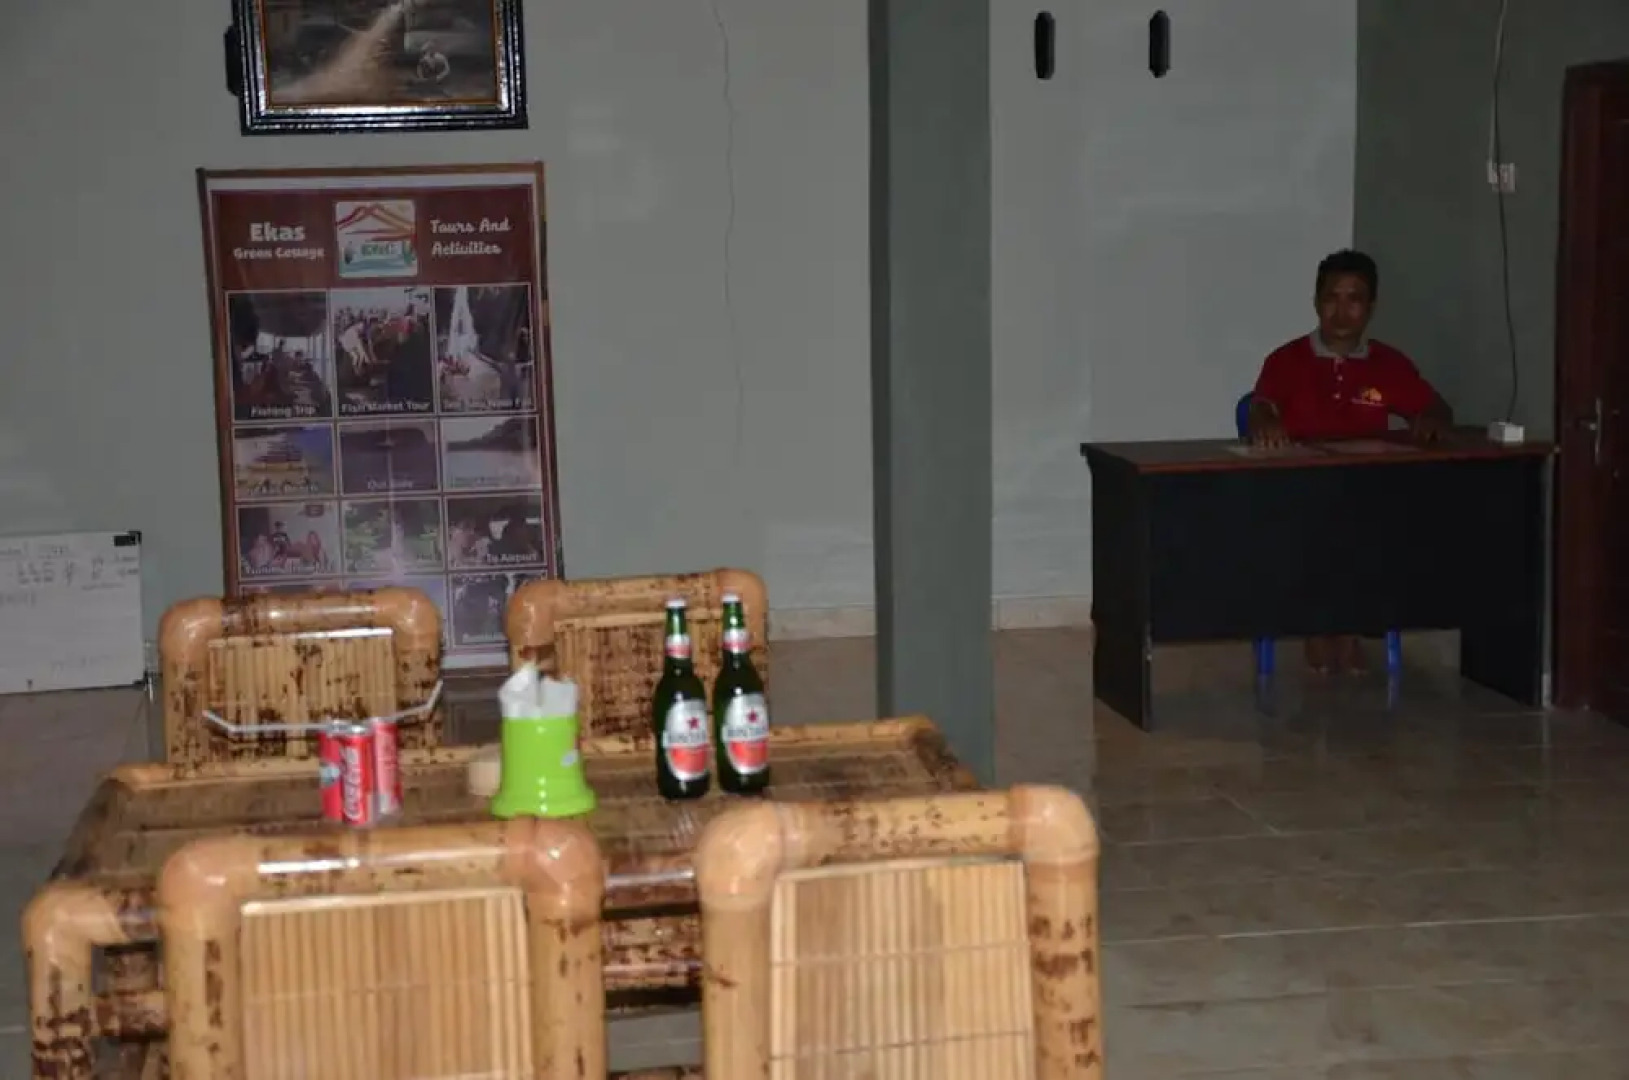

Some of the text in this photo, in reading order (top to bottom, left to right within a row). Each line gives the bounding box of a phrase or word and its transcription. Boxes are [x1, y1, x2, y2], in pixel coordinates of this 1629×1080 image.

[249, 221, 306, 242] Ekas
[429, 216, 512, 234] Tours And
[431, 240, 503, 256] Activities
